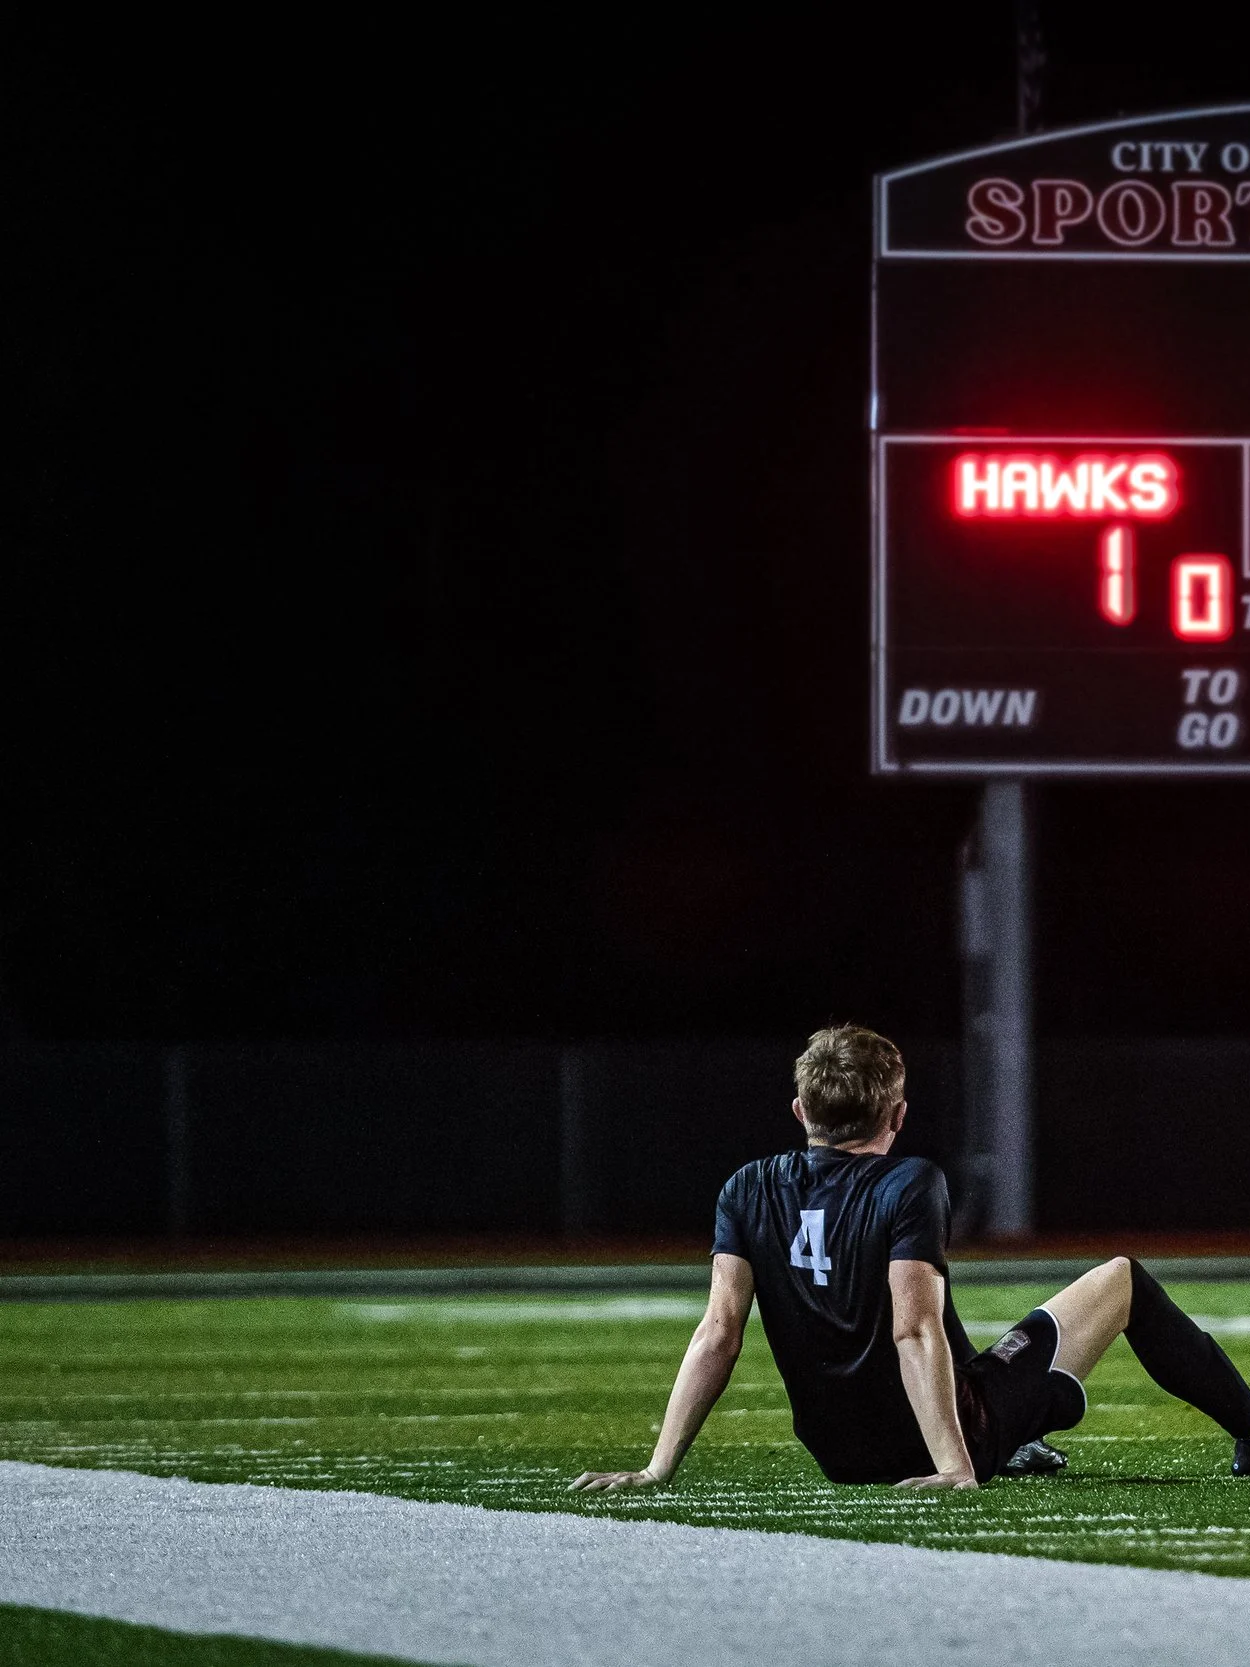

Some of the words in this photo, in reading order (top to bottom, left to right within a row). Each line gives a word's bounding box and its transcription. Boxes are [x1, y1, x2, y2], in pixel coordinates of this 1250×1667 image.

[1111, 141, 1208, 173] CITY
[957, 457, 1173, 515] HAWKS
[1104, 525, 1126, 620] 1
[1176, 562, 1222, 636] 0
[898, 690, 1037, 726] DOWN
[1181, 668, 1240, 705] TO
[1176, 712, 1240, 748] GO
[789, 1208, 833, 1287] 4
